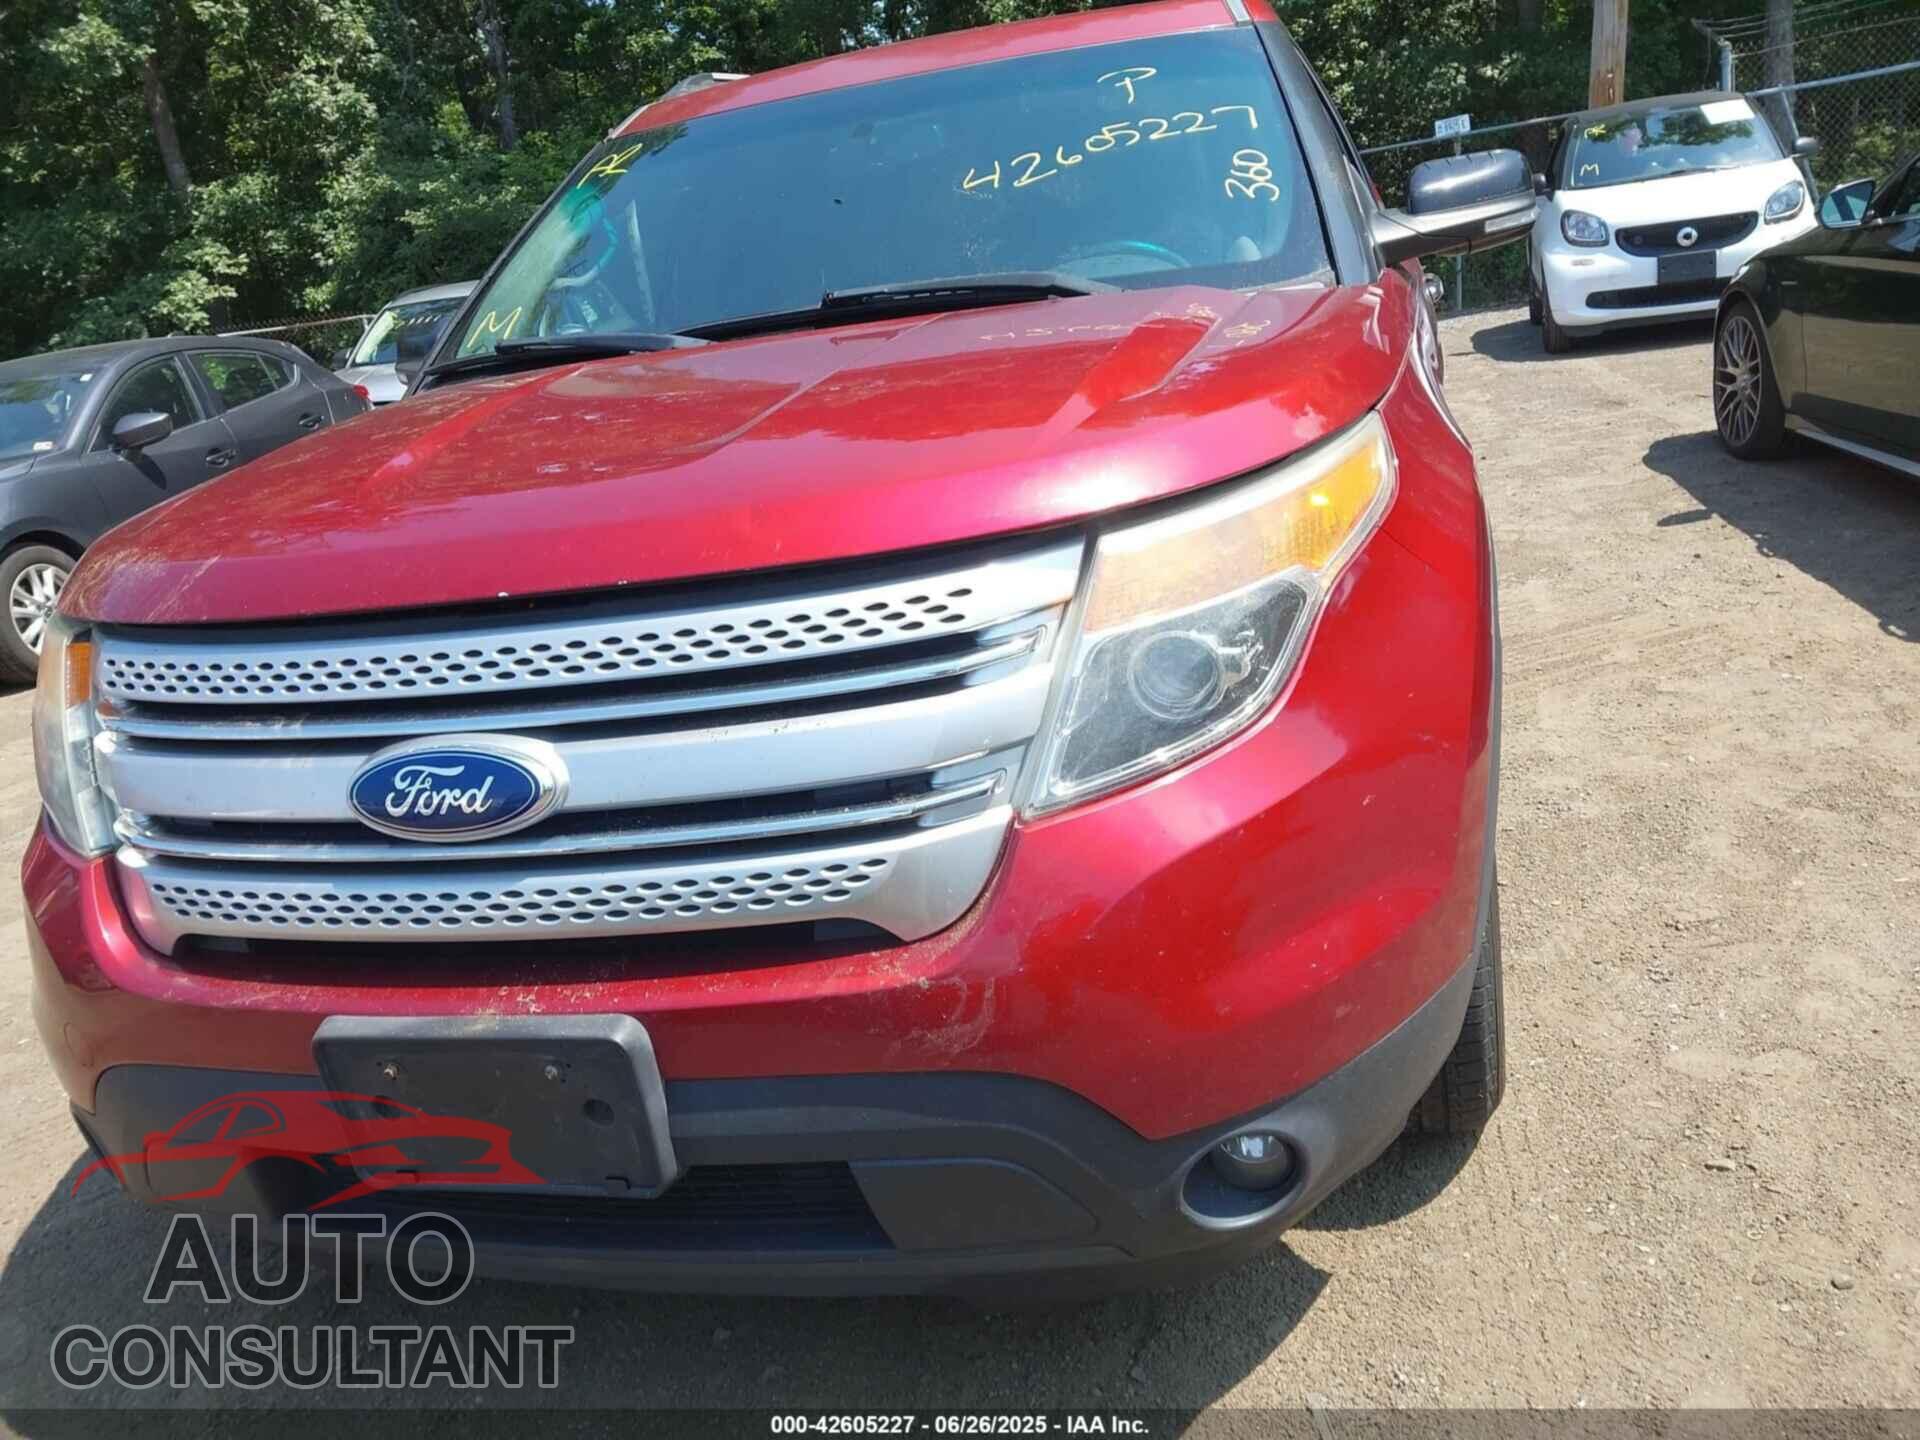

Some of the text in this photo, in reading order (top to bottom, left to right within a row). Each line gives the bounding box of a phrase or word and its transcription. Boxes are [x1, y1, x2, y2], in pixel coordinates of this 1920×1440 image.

[962, 105, 1258, 189] 42605227
[1580, 164, 1599, 176] M
[466, 306, 523, 348] M
[384, 765, 494, 817] Ford
